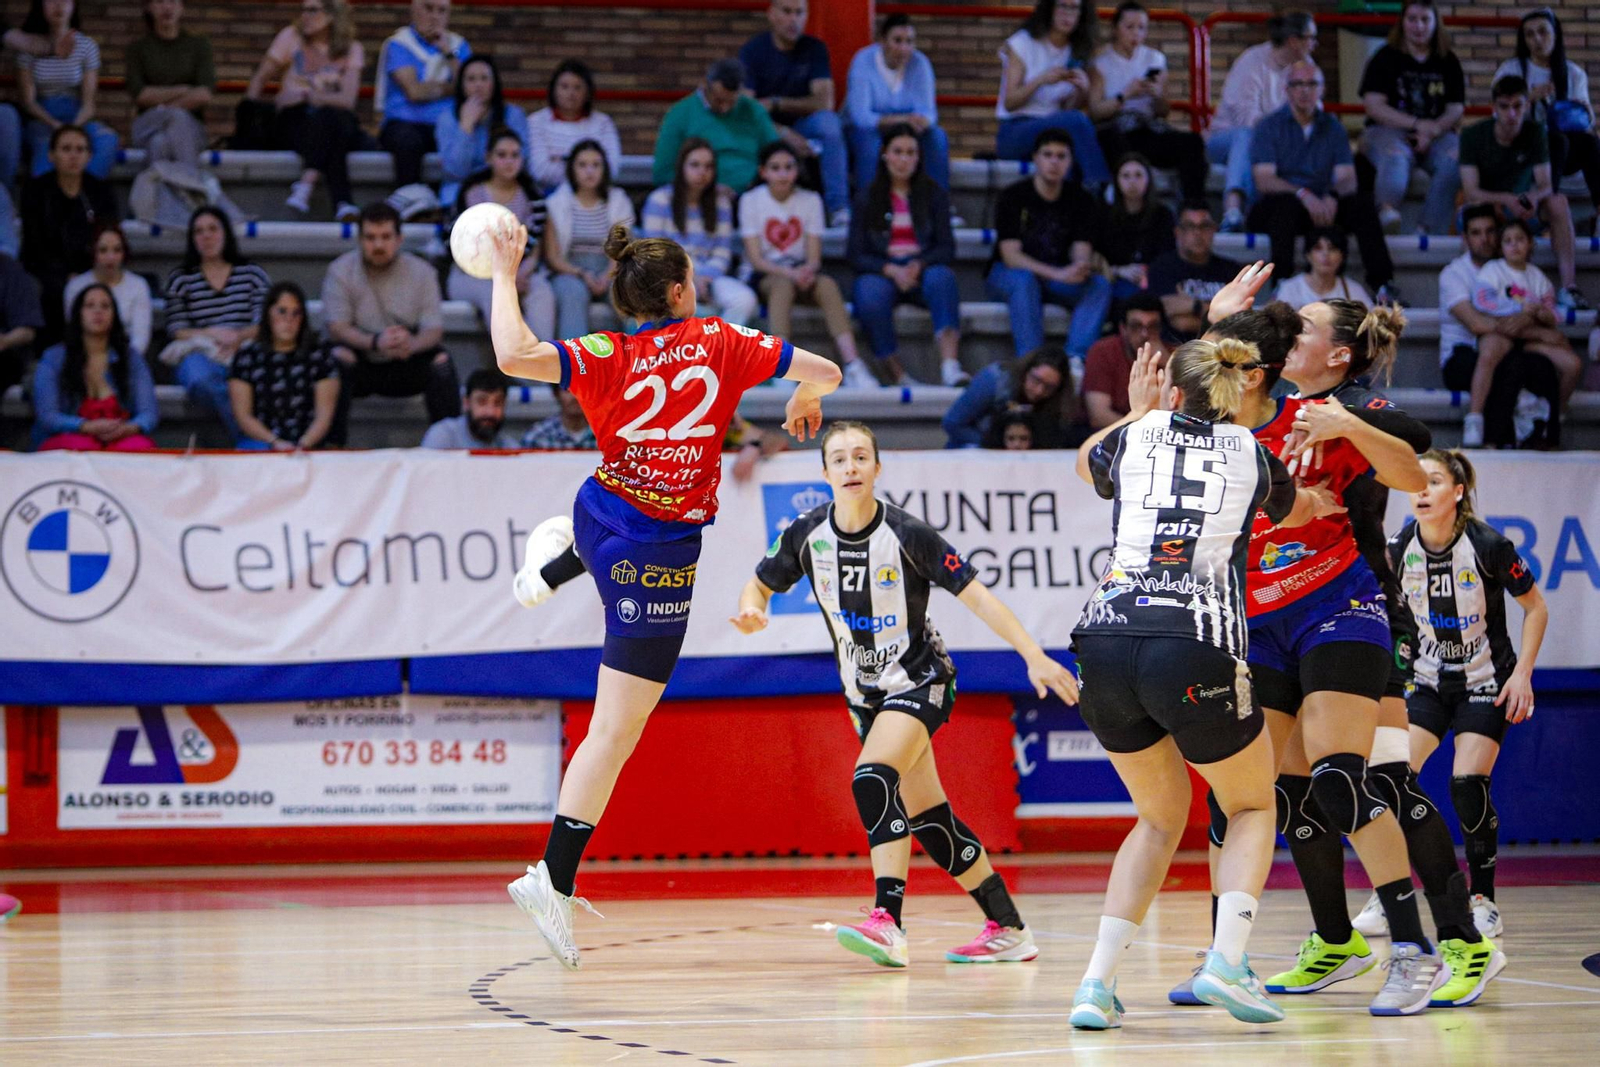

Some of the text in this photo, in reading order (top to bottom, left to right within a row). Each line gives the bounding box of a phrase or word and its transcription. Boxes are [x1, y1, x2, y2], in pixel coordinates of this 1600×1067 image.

[638, 343, 708, 374] ABANCA
[616, 365, 721, 443] 22
[1141, 427, 1241, 452] BERASATEGI
[1142, 444, 1227, 515] 15
[17, 487, 120, 526] BMW
[1155, 518, 1202, 538] raíz
[1402, 514, 1600, 591] BA
[842, 565, 867, 592] 27
[1430, 573, 1453, 597] 20
[646, 601, 691, 615] INDUP
[1415, 610, 1480, 631] málaga
[321, 740, 507, 766] 670 33 84 48
[64, 791, 275, 807] ALONSO & SERODIO
